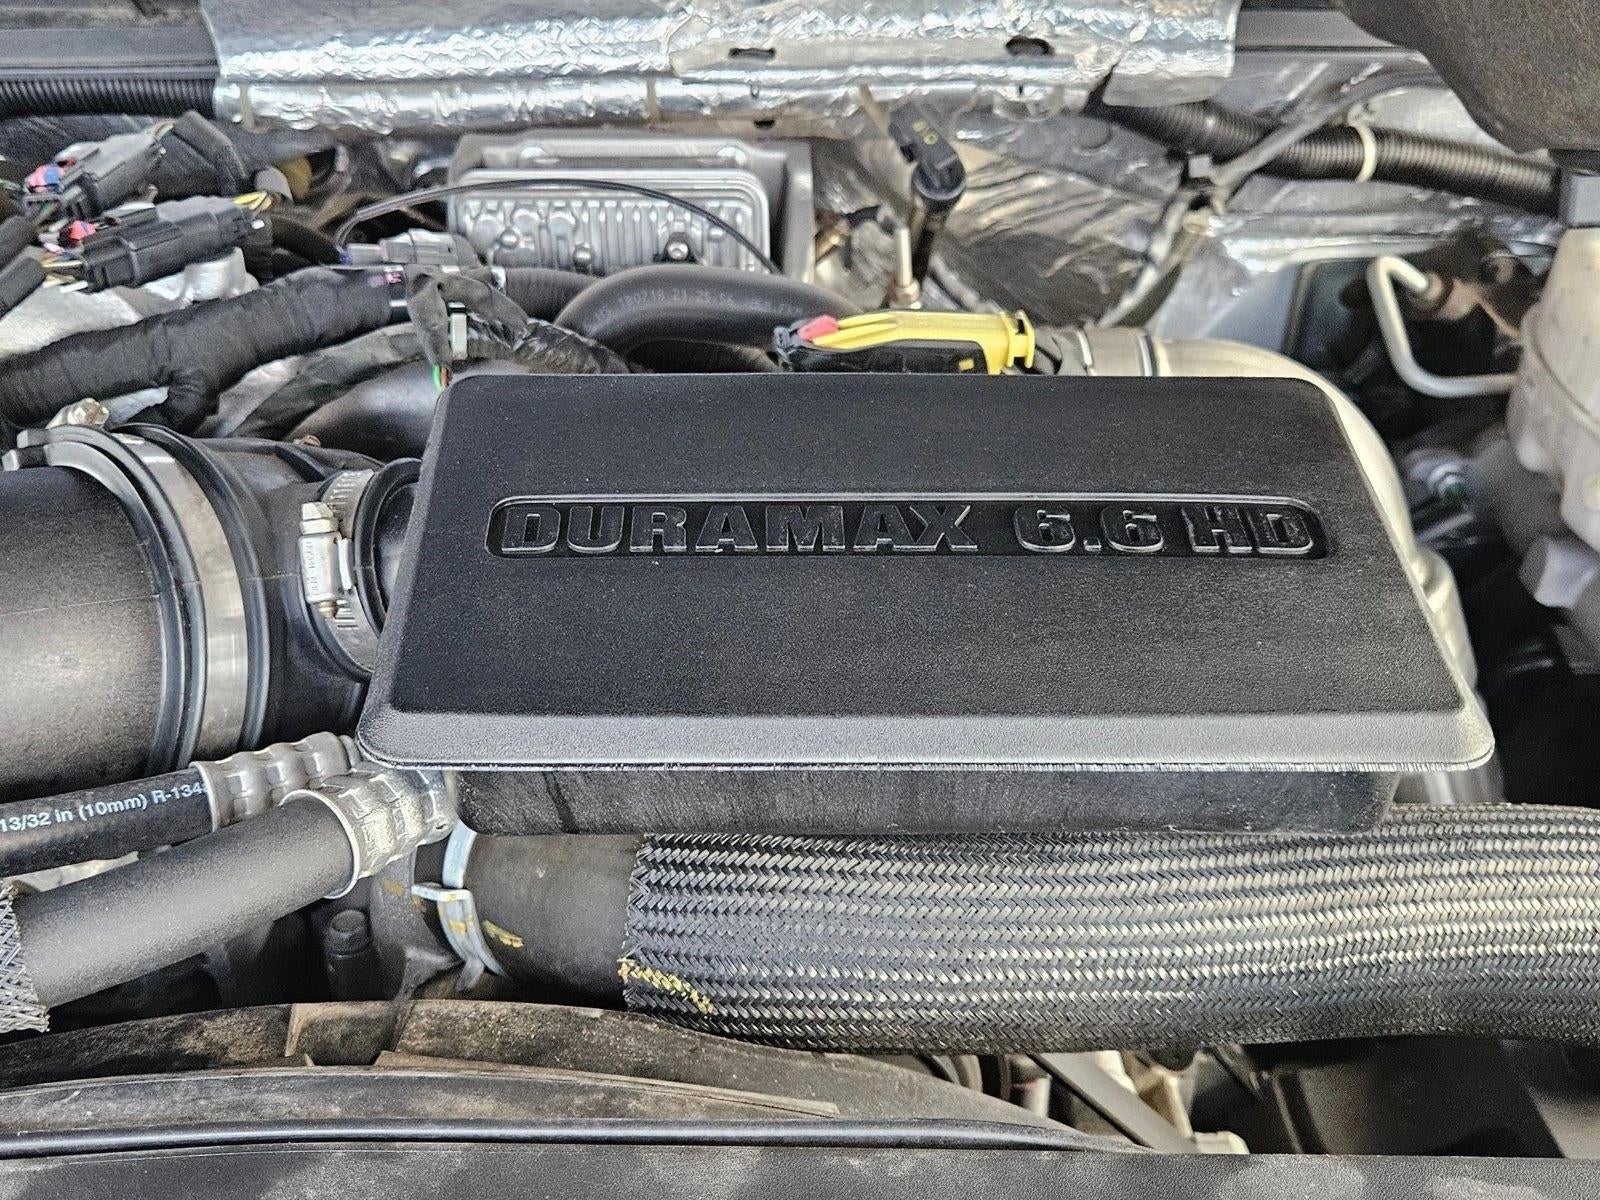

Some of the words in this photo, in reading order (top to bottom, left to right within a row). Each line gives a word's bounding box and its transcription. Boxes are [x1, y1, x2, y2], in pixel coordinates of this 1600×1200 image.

[501, 505, 978, 553] DURAMAX
[1014, 504, 1164, 552] 6.6
[1180, 504, 1314, 554] HD
[0, 811, 52, 832] 13/32
[54, 809, 74, 823] in
[78, 793, 148, 821] (10mm)
